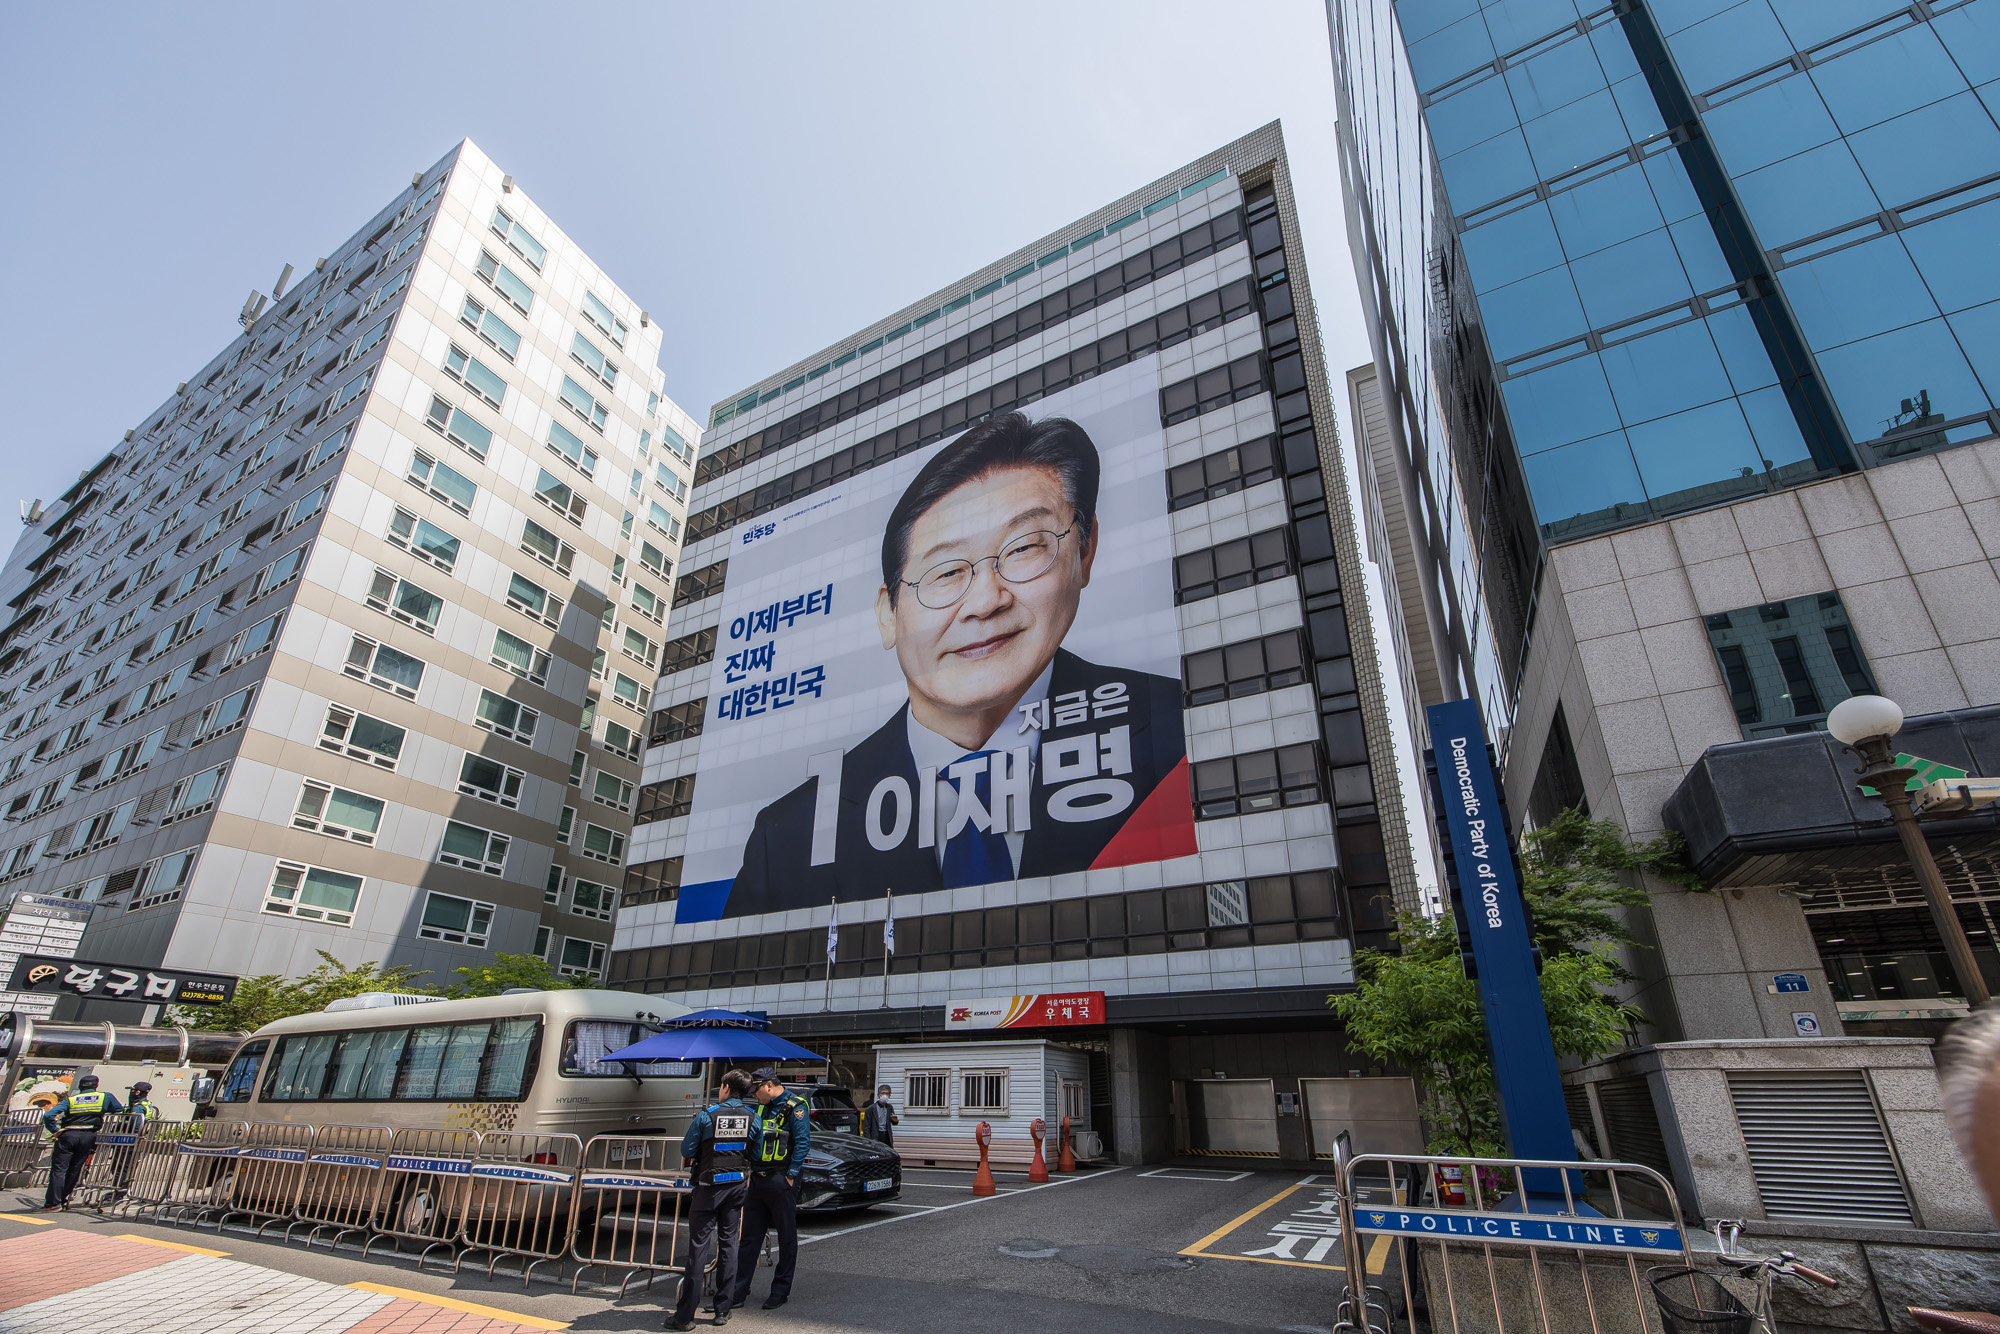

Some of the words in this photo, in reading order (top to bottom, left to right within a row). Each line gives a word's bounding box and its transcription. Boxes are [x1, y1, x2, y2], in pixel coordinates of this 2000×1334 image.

[743, 522, 776, 544] 민주당
[730, 583, 833, 642] 이제부터
[724, 640, 776, 684] 진짜
[718, 664, 826, 721] 대한민국
[1018, 682, 1130, 735] 지금은
[1450, 737, 1480, 817] Democratic
[865, 724, 1134, 852] 이재명
[807, 748, 844, 866] 1
[1468, 819, 1489, 859] Party
[1478, 863, 1497, 879] of
[1481, 882, 1502, 928] Korea
[187, 981, 226, 992] 한우전문점
[1786, 982, 1800, 991] 11
[181, 992, 224, 1001] 02)782-8858
[1046, 998, 1090, 1006] 서울여의도광장
[1045, 1006, 1090, 1020] 우체국
[719, 1118, 745, 1129] 경찰
[251, 1149, 276, 1158] POLICE
[278, 1151, 296, 1160] LINE
[320, 1154, 349, 1163] POLICE
[352, 1156, 371, 1165] LINE
[612, 1144, 646, 1158] 77933
[396, 1159, 431, 1170] POLICE
[437, 1162, 460, 1172] LINE
[1400, 1214, 1522, 1236] POLICE
[1546, 1224, 1626, 1244] LINE
